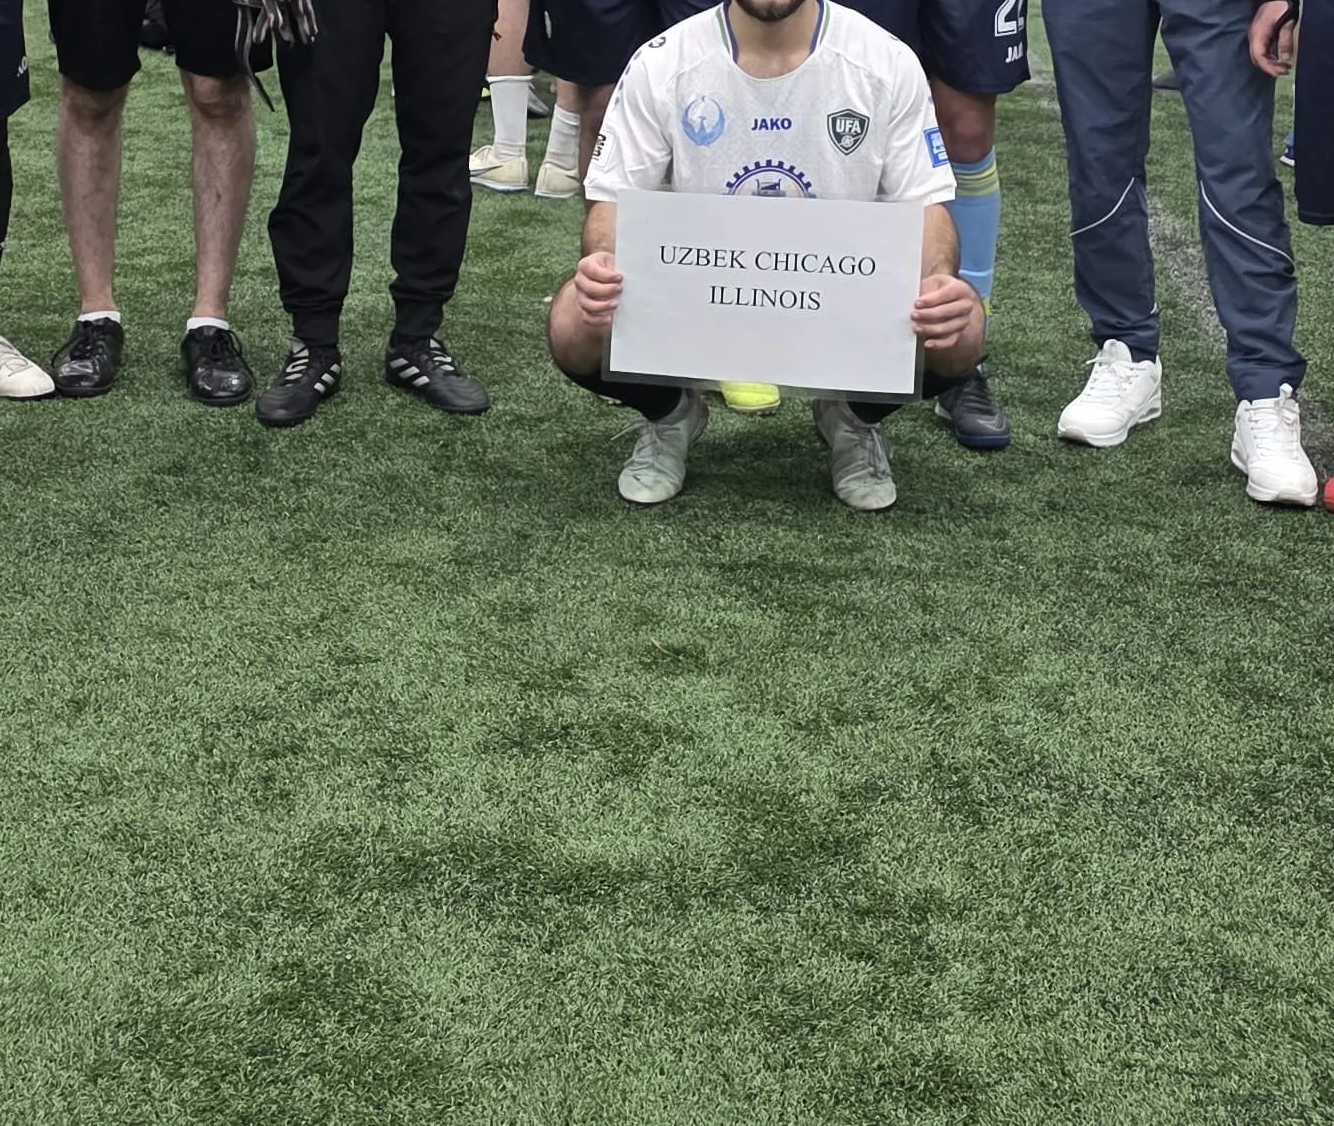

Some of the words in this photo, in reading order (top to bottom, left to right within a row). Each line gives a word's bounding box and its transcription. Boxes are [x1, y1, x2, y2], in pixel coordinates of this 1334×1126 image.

[751, 118, 793, 132] JAKO
[836, 118, 862, 135] UFA
[659, 245, 747, 270] UZBEK
[755, 251, 876, 276] CHICAGO
[709, 285, 821, 311] ILLINOIS
